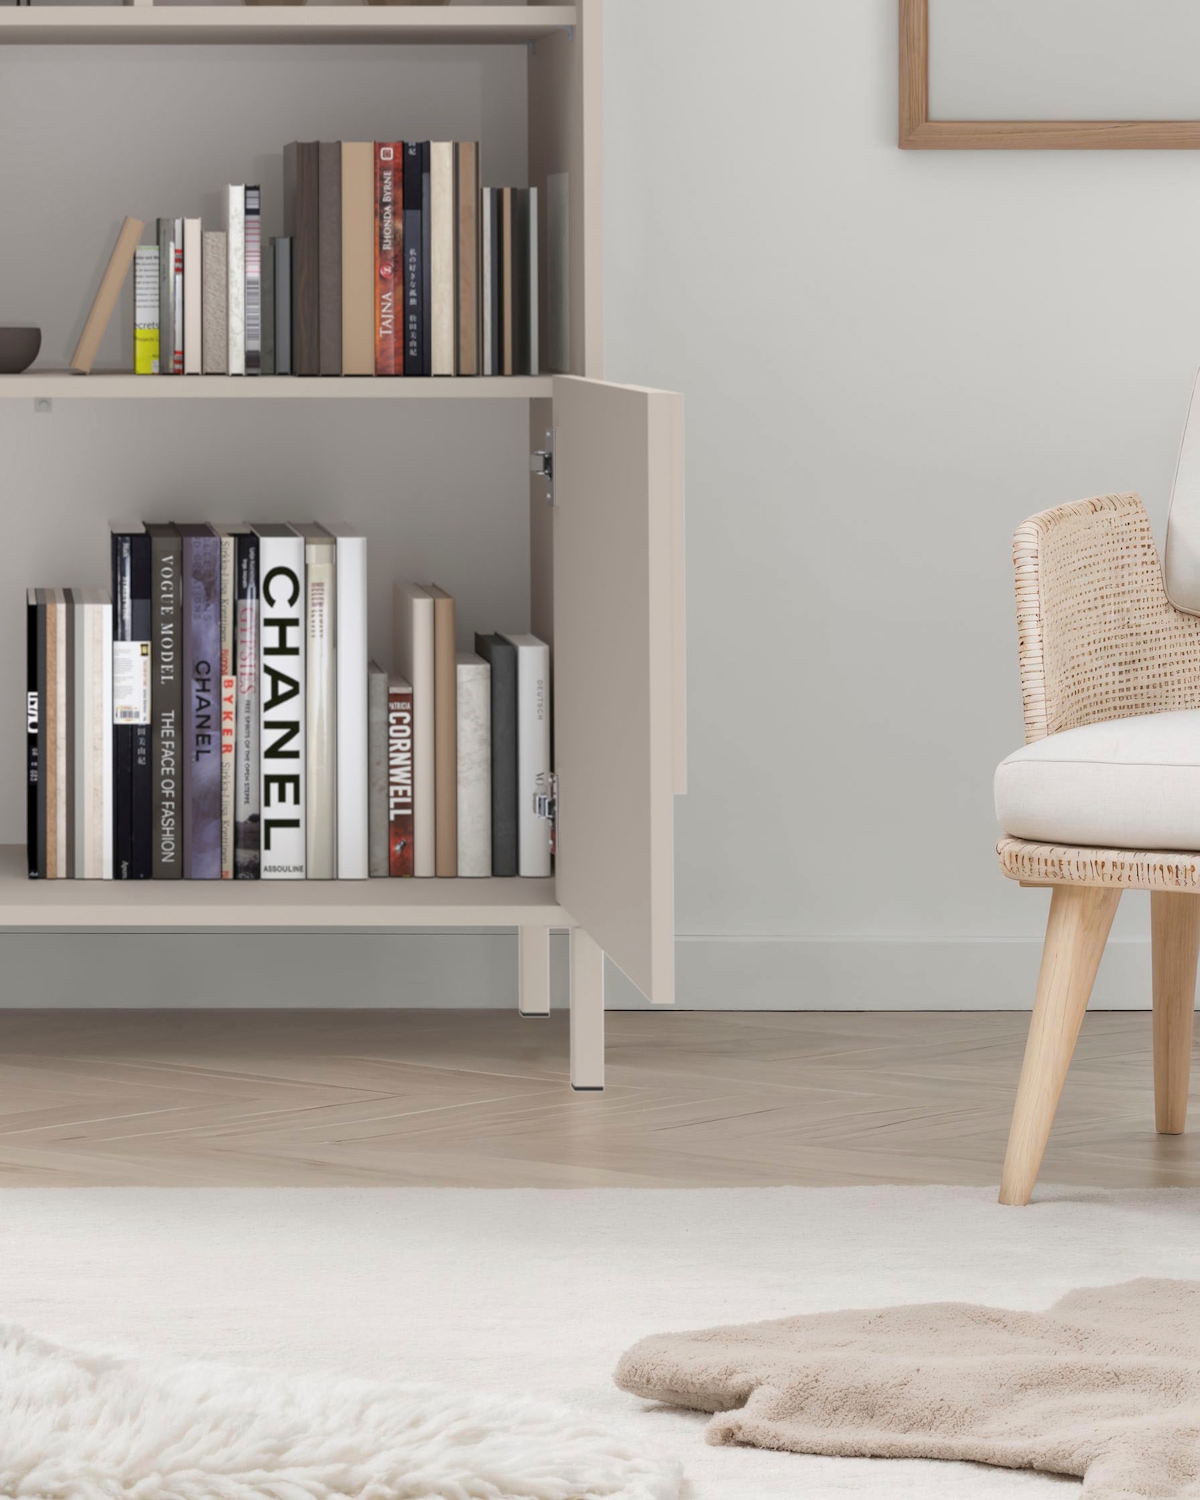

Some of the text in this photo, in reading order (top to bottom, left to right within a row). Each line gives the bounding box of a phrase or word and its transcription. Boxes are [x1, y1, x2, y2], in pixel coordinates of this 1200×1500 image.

[382, 171, 393, 251] RHONDA BYRNE
[380, 291, 394, 338] TAJNA
[161, 555, 174, 685] VOGUE MODEL
[240, 607, 256, 695] GYPSIES
[195, 660, 211, 763] CHANEL
[222, 679, 234, 754] BYKER
[244, 699, 252, 714] FREE
[244, 715, 252, 739] SPIRITS
[263, 566, 300, 851] CHANEL
[536, 679, 544, 720] DEUTSCH
[244, 740, 252, 749] OF
[389, 712, 412, 821] CORNWELL
[161, 709, 175, 863] THE FACE OF FASHION
[263, 865, 304, 873] ASSOULINE
